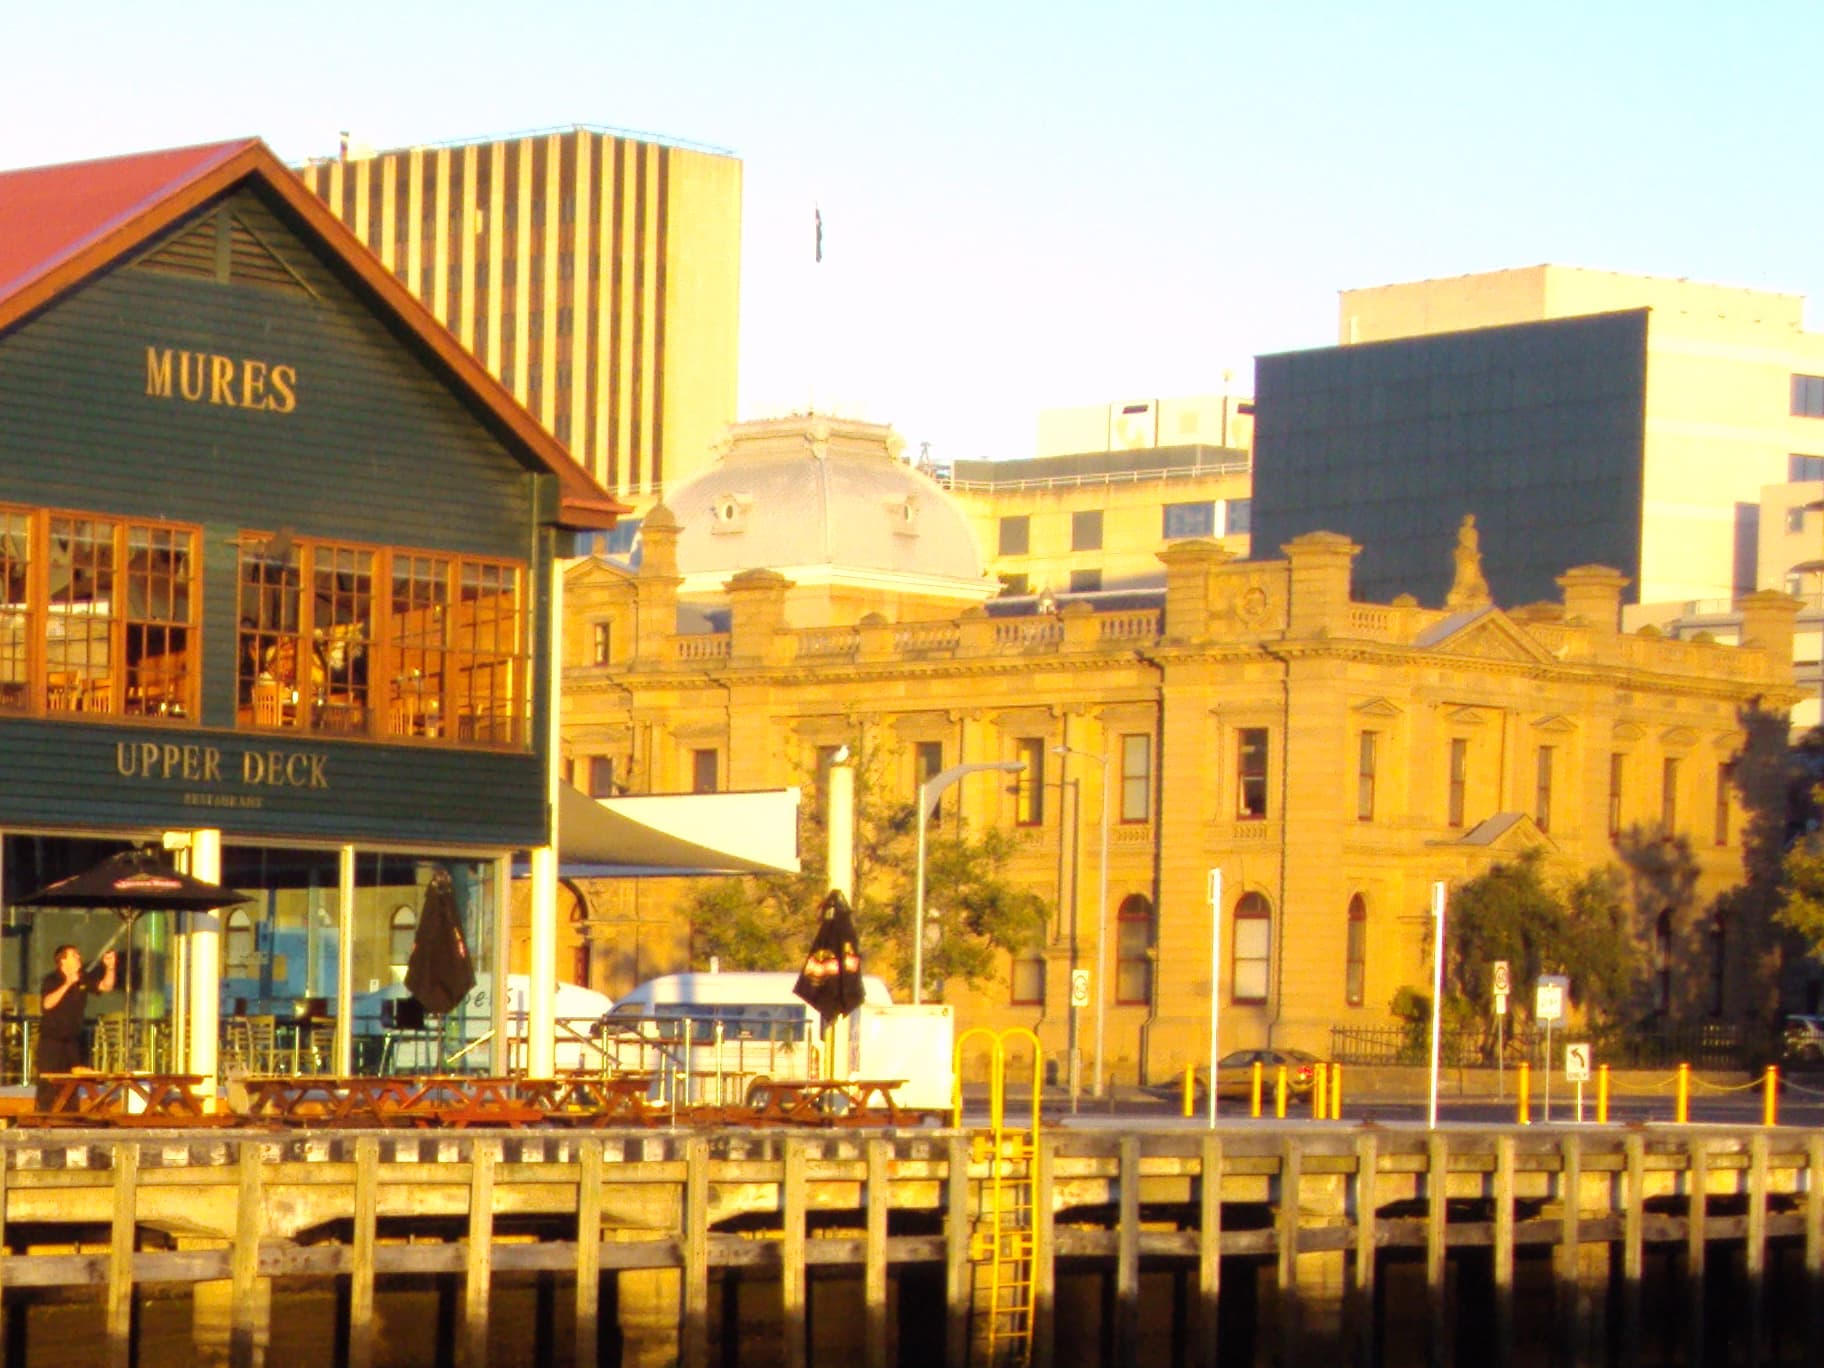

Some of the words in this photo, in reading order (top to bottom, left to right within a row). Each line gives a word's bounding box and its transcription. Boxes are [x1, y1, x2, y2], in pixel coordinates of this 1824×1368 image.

[144, 345, 297, 414] MURES
[115, 740, 222, 782] UPPER
[242, 750, 330, 788] DECK
